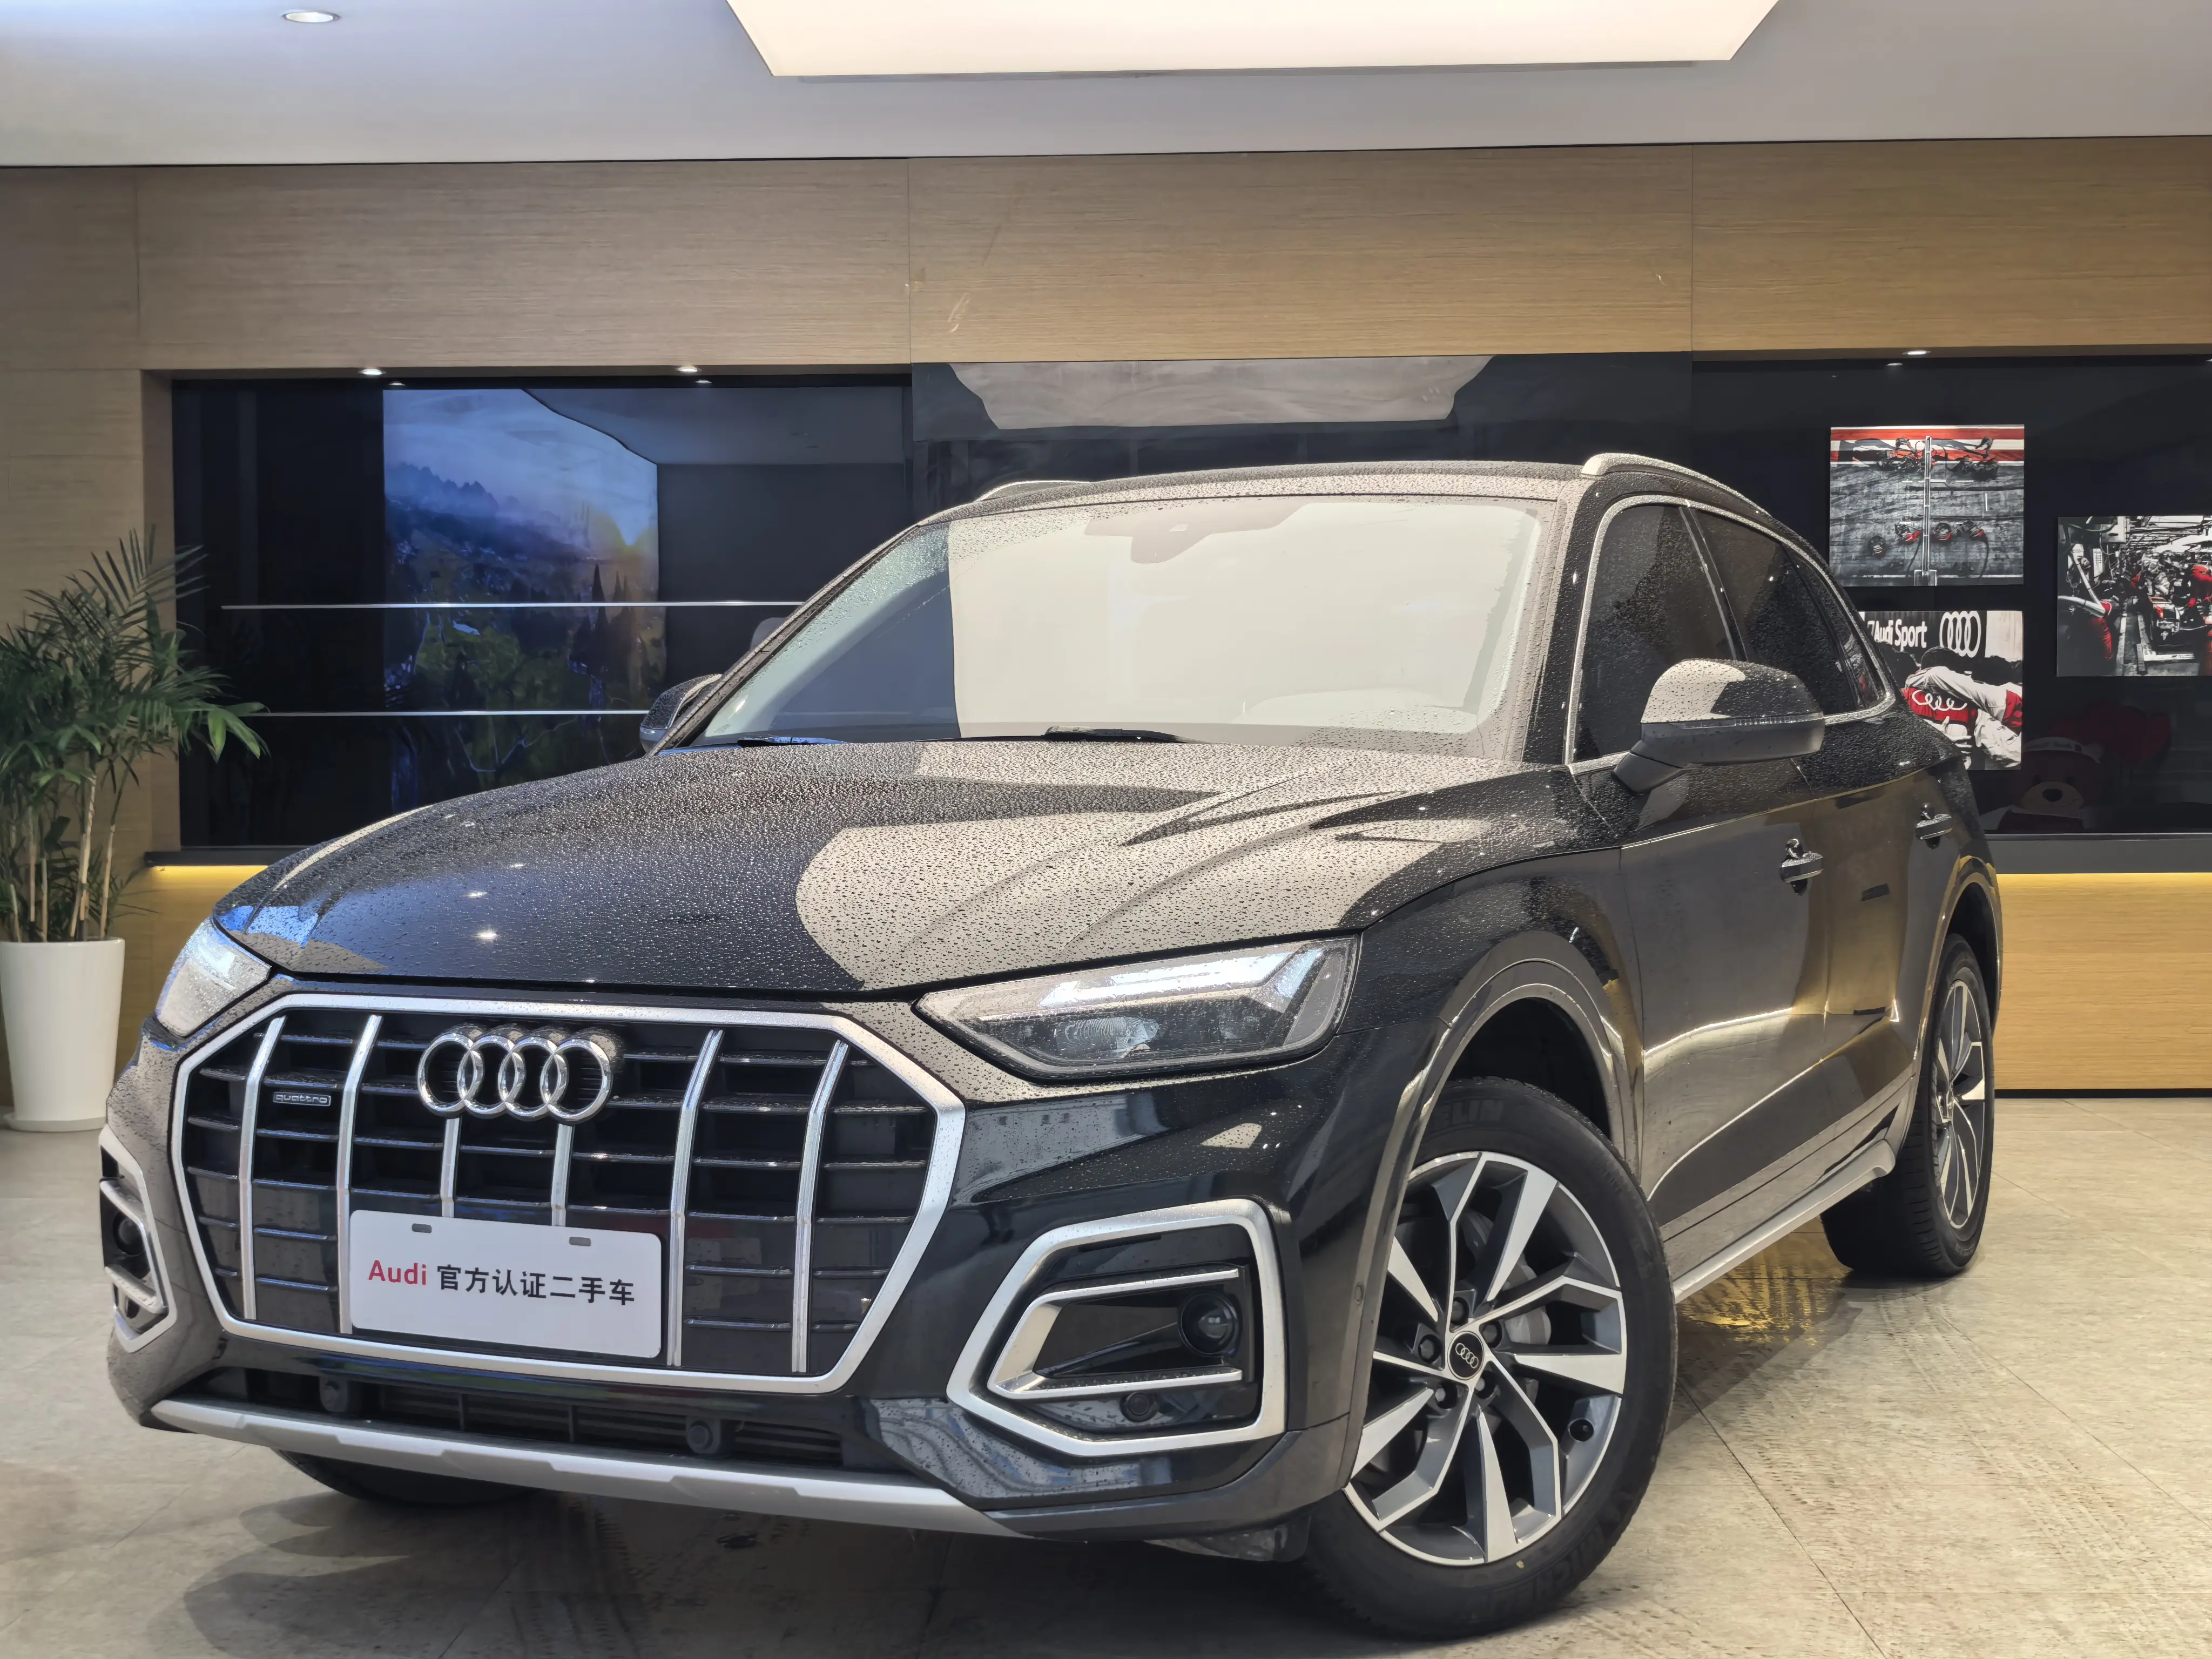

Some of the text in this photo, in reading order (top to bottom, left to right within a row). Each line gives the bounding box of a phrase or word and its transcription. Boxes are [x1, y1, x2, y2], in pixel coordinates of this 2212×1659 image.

[1874, 619, 1927, 652] Audi Sport
[275, 1094, 327, 1103] quattro
[368, 1260, 635, 1305] Audi 官方认证二手车
